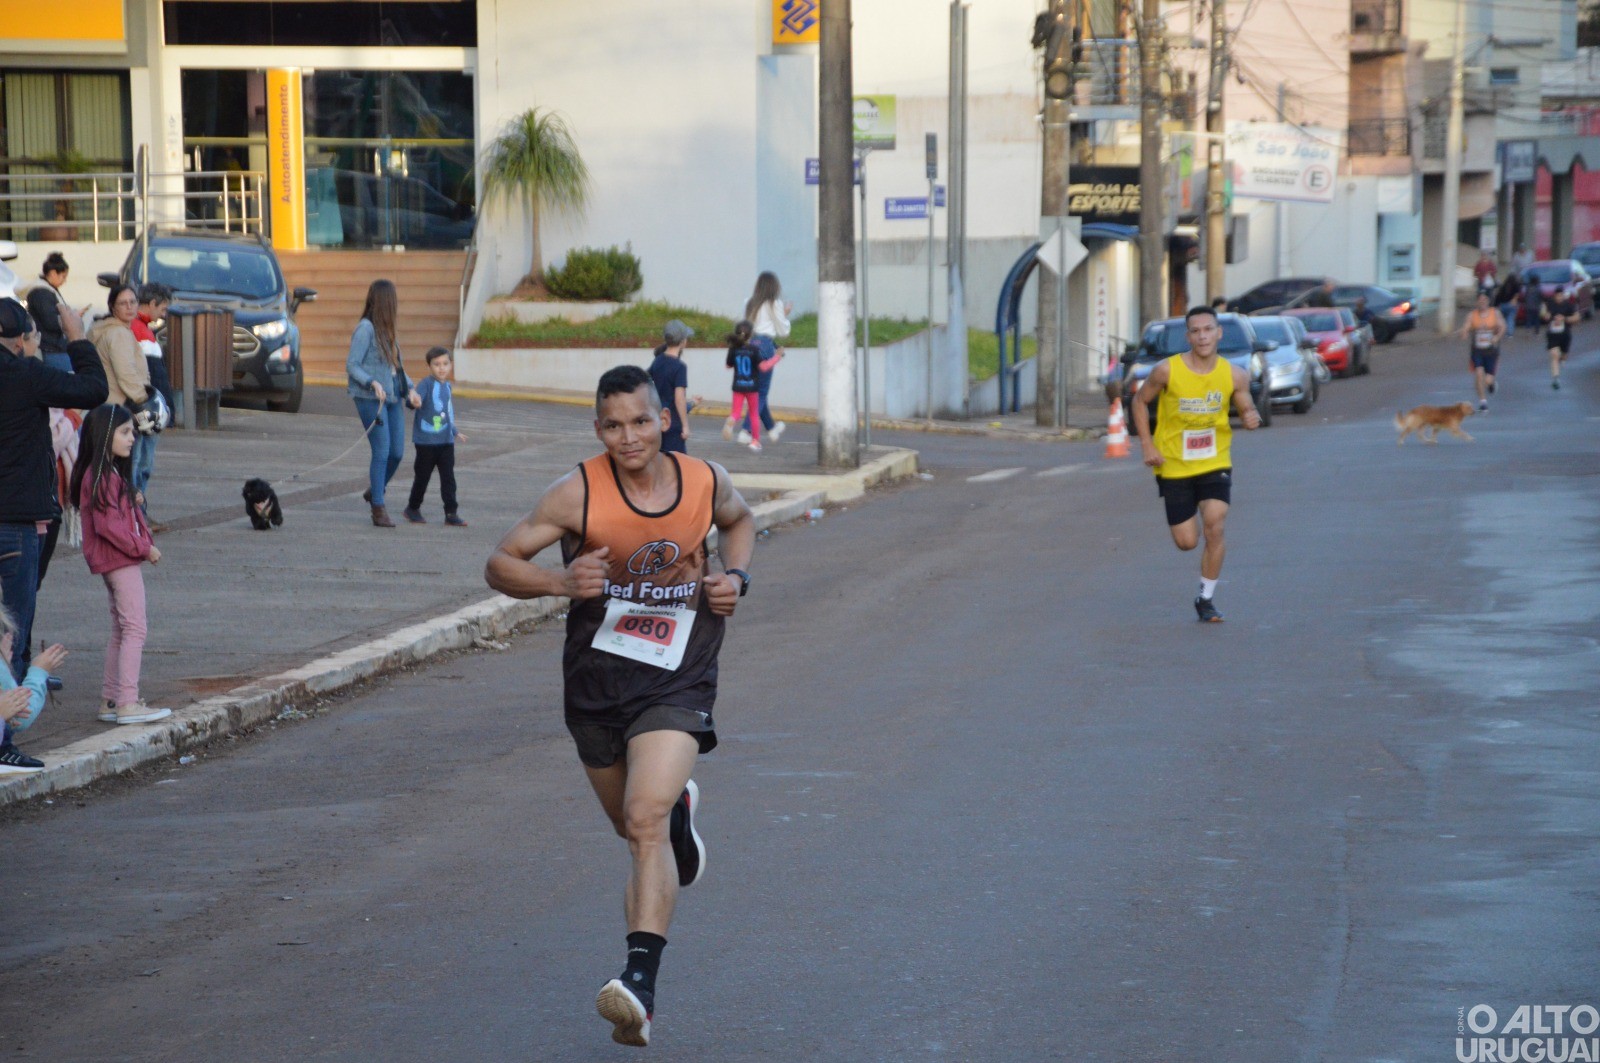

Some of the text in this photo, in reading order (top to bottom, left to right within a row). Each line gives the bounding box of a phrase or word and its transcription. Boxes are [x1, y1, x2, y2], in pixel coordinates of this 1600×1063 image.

[280, 84, 290, 203] Autoatendimento
[1310, 171, 1323, 187] E
[735, 355, 751, 375] 10
[1191, 436, 1211, 448] 070
[624, 618, 670, 639] 080
